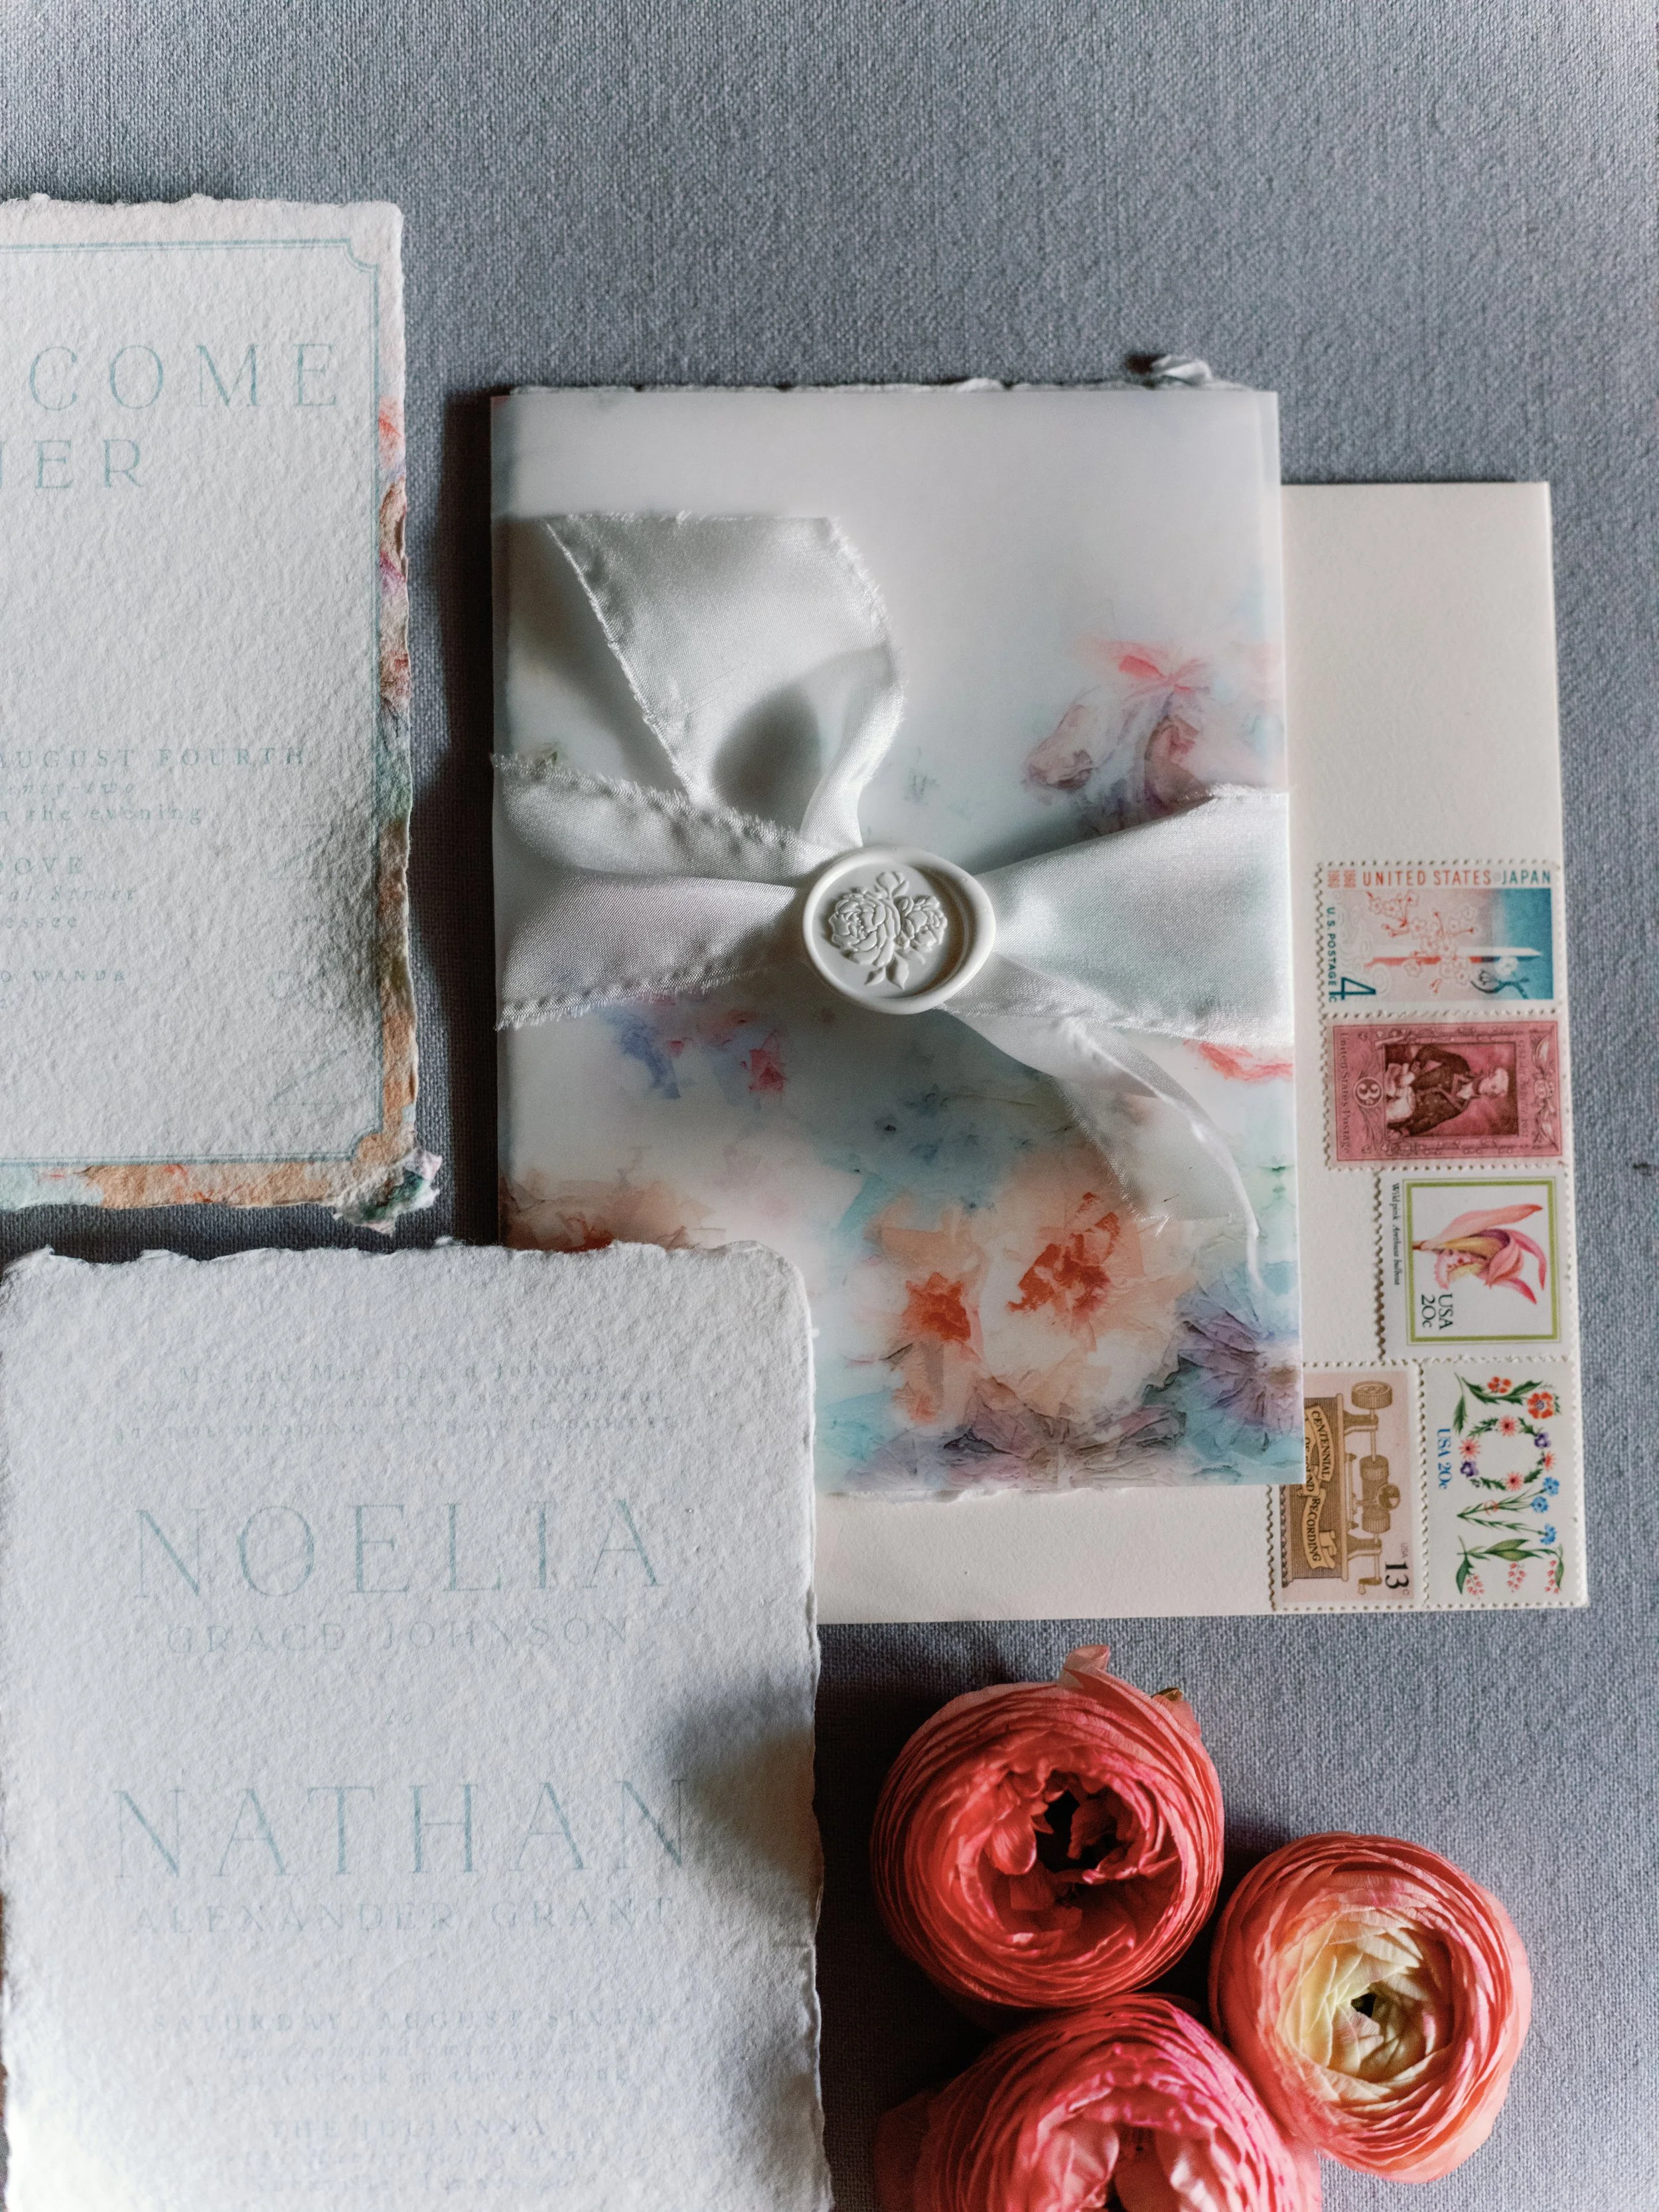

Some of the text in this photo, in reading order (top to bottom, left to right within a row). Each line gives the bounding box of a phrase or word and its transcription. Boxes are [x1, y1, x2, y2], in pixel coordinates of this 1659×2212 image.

[0, 439, 144, 488] ER
[159, 747, 305, 767] FOURTH
[90, 803, 202, 825] evening
[0, 857, 82, 875] OVE
[1362, 869, 1426, 887] UNITED
[1433, 869, 1491, 886] STATES
[1502, 869, 1551, 885] JAPAN
[1327, 933, 1336, 986] POSTAGE
[1340, 1071, 1350, 1107] States
[1340, 1110, 1352, 1154] Postage
[1438, 1293, 1453, 1330] USA
[1311, 1410, 1331, 1479] CENTENNIAL
[1436, 1428, 1452, 1457] USA
[134, 1498, 665, 1597] NOELIA
[1307, 1498, 1321, 1562] RECORDING
[167, 1615, 628, 1653] GRACE JOHNSON
[113, 1779, 689, 1879] NATHAN
[133, 1895, 674, 1934] ALEXANDER GRANT
